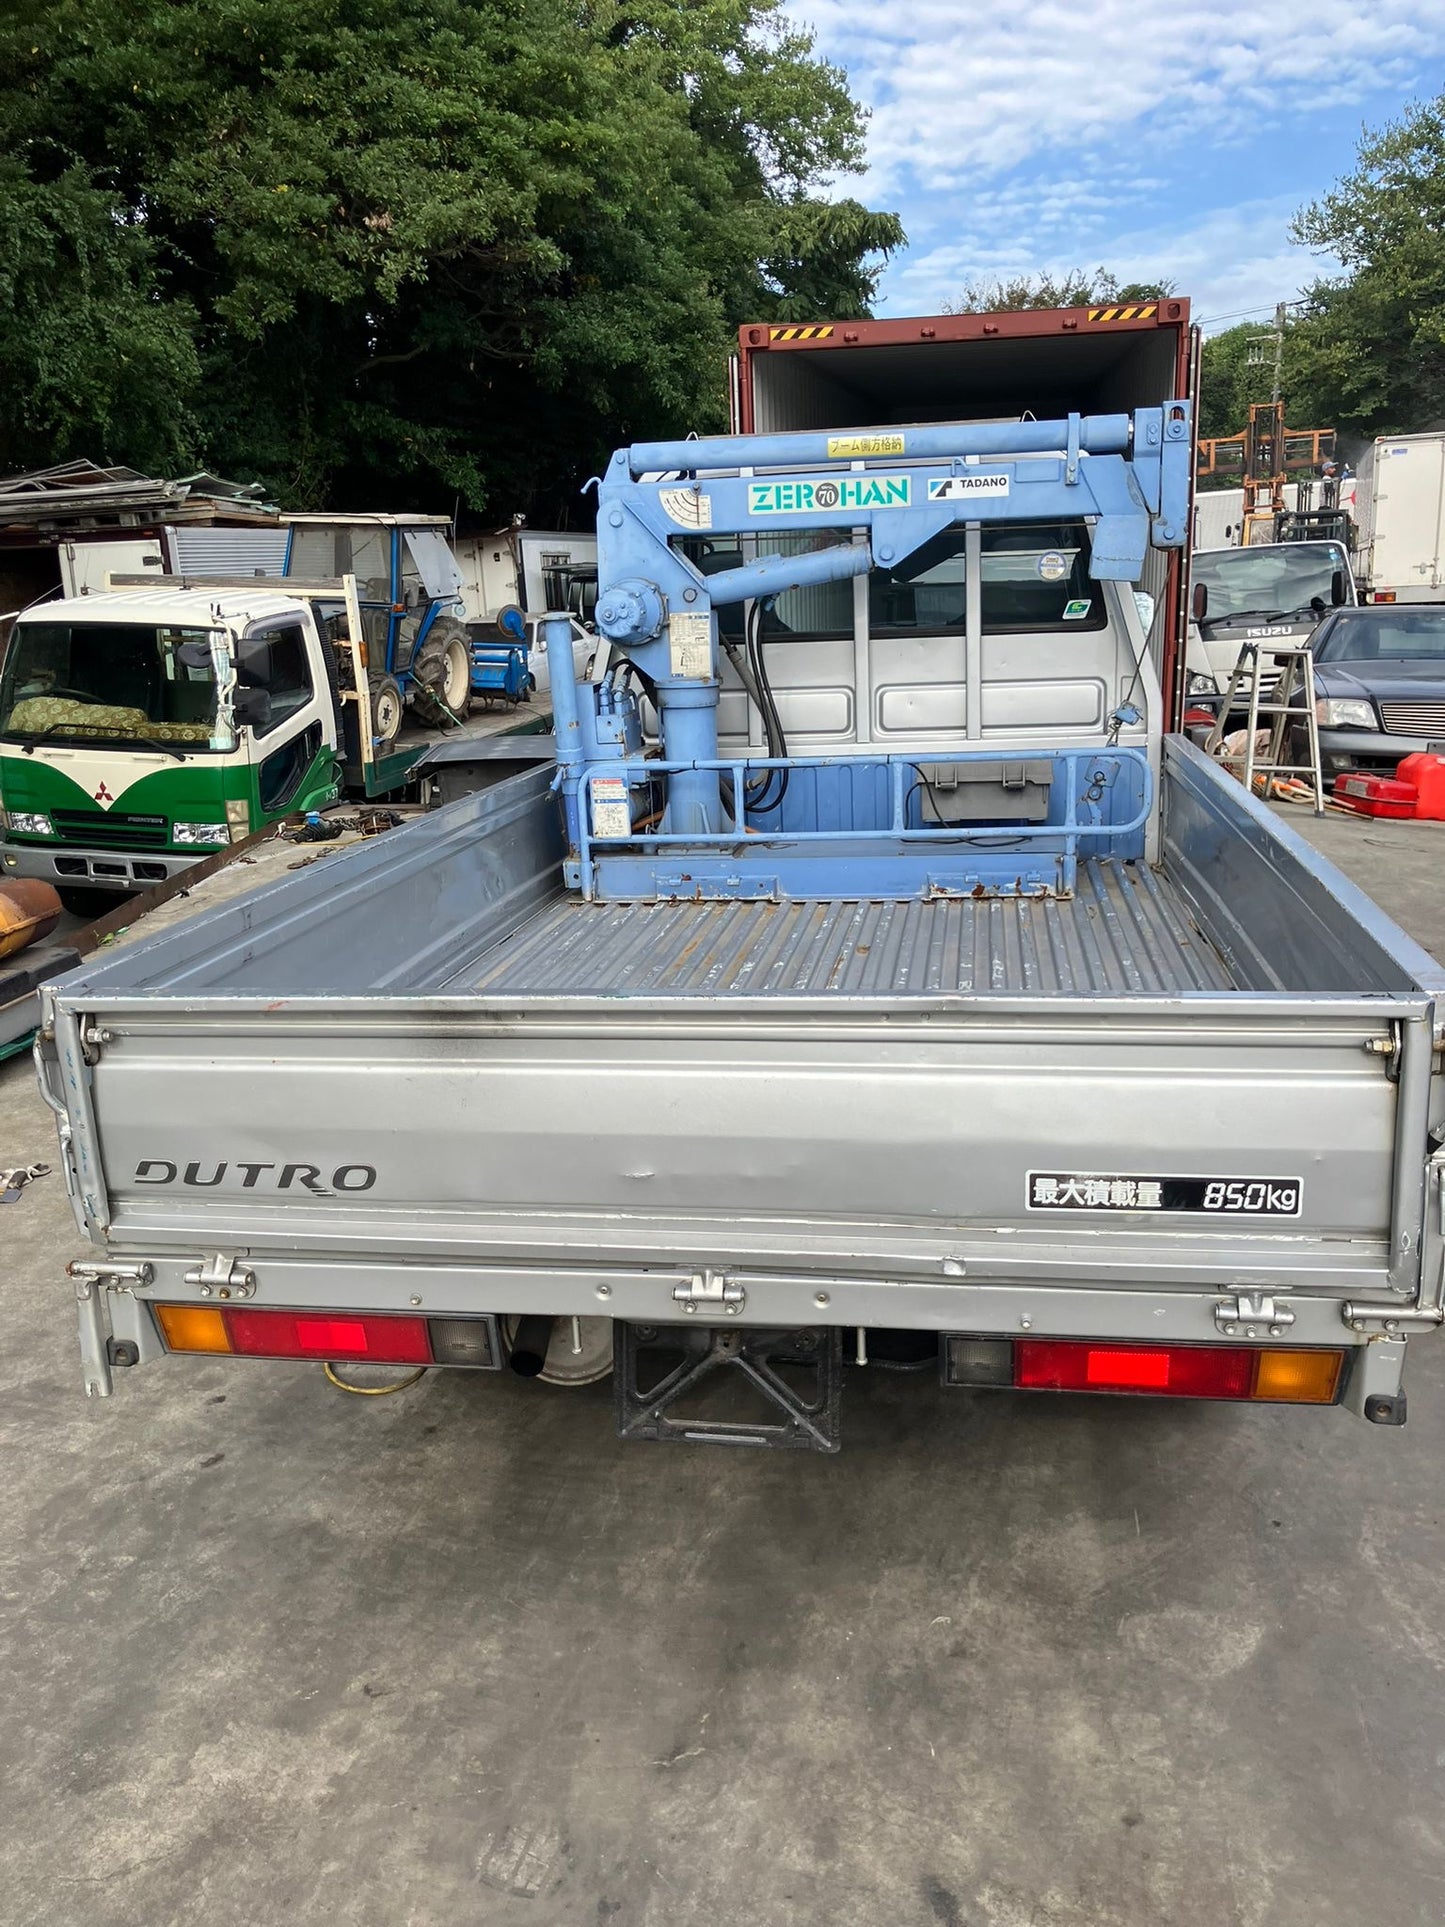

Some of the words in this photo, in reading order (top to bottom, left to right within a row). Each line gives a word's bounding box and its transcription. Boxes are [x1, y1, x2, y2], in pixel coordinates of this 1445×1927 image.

[831, 437, 902, 453] ブーム側方格納
[960, 477, 1007, 488] TADANO
[1246, 625, 1292, 638] ISUZU
[134, 1159, 377, 1198] DUTRO
[1033, 1178, 1163, 1208] 最大積載量
[1202, 1182, 1297, 1212] 850kg
